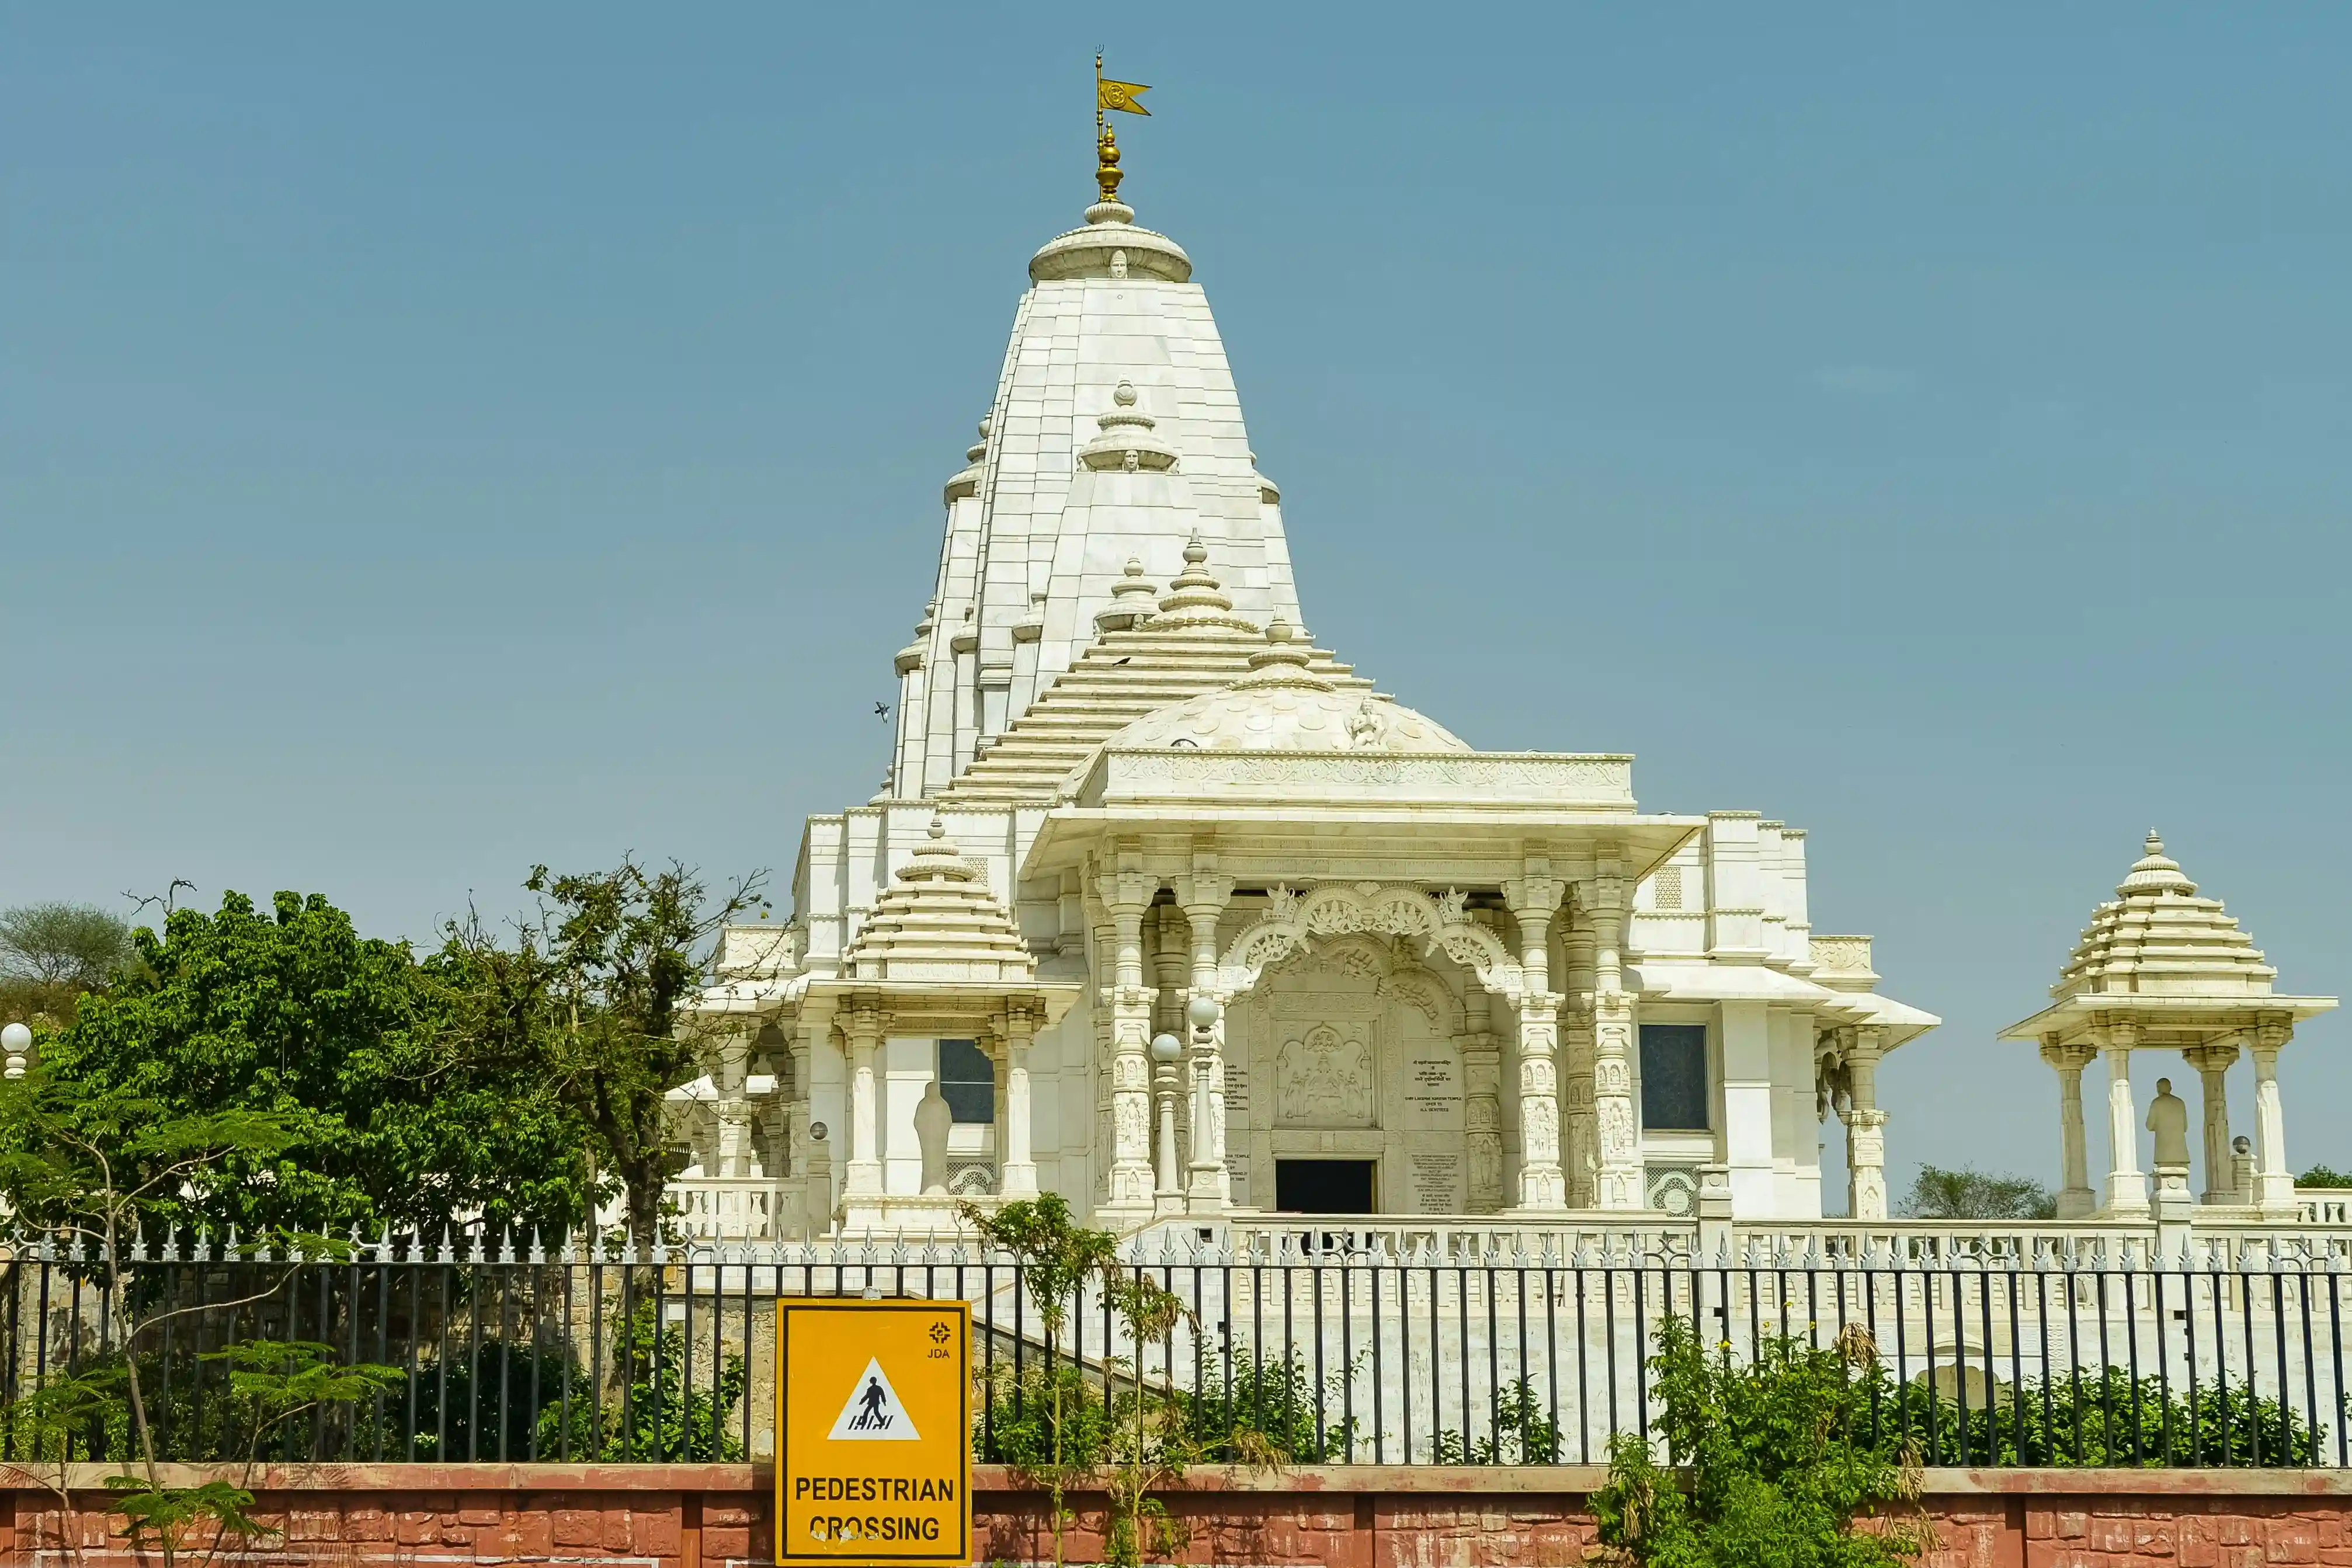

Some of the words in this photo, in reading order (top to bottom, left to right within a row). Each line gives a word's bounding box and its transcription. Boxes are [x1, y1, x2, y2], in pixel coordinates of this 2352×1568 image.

[927, 1348, 950, 1359] JDA
[795, 1476, 954, 1501] PEDESTRIAN
[810, 1515, 939, 1541] CROSSING
